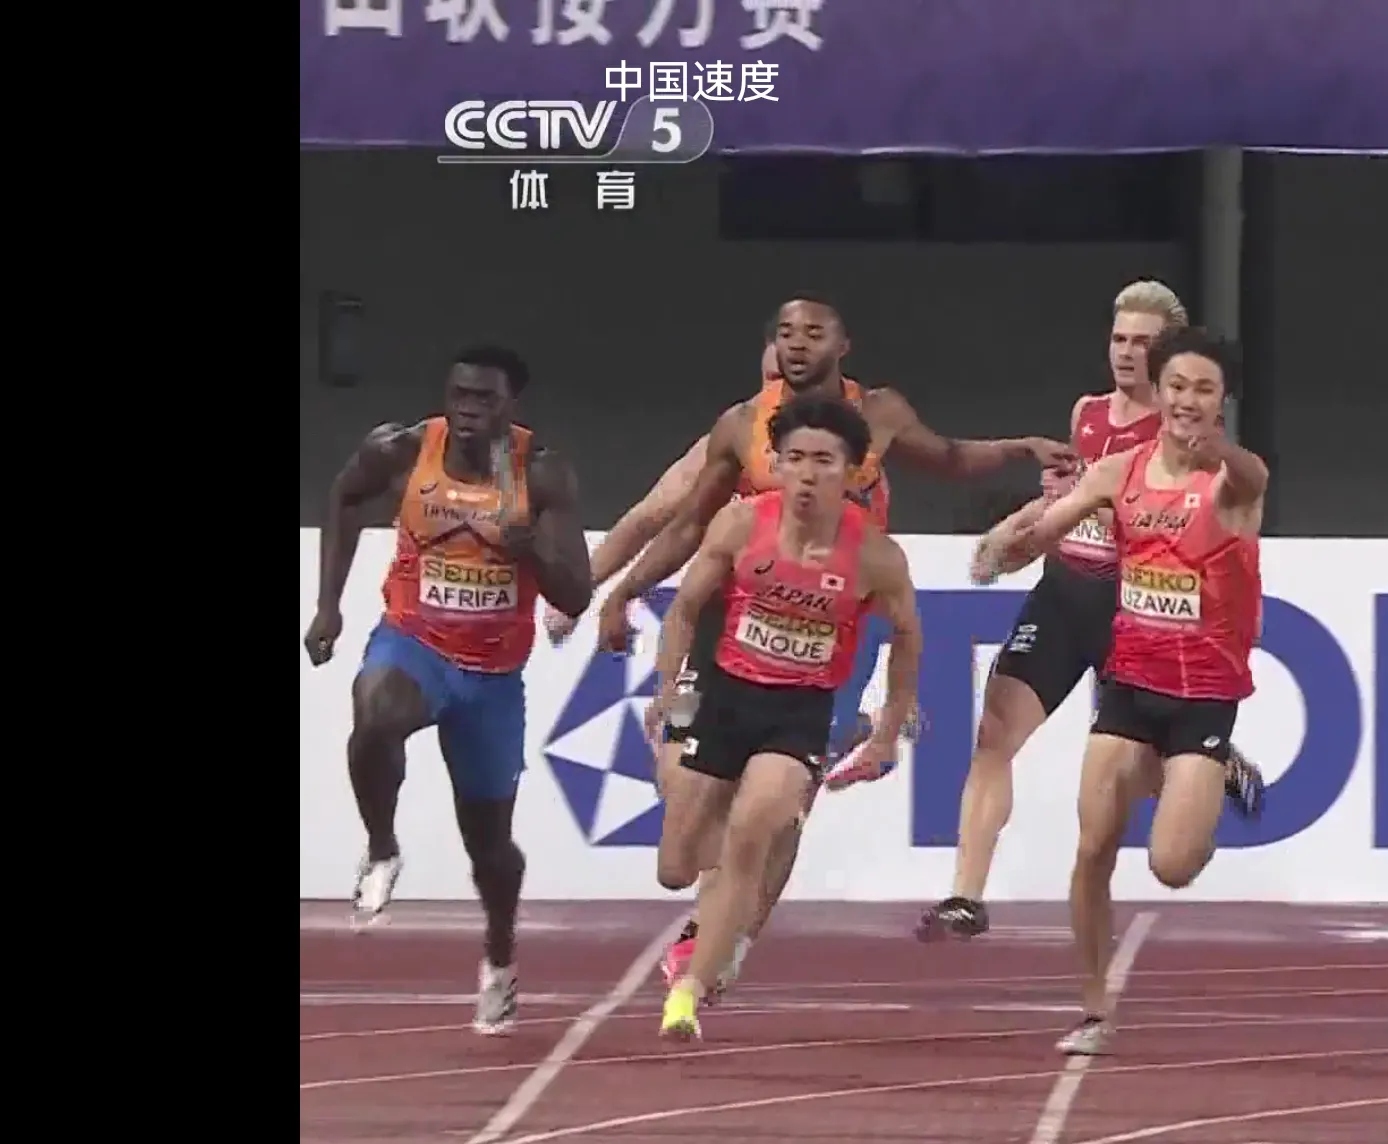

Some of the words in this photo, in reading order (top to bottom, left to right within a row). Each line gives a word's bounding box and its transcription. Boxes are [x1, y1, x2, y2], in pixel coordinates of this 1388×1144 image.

[423, 560, 513, 585] SEIKO
[1124, 563, 1197, 593] SEIKO
[426, 584, 511, 608] AFRIFA
[1124, 586, 1194, 617] UZAWA
[745, 622, 826, 659] INOUE
